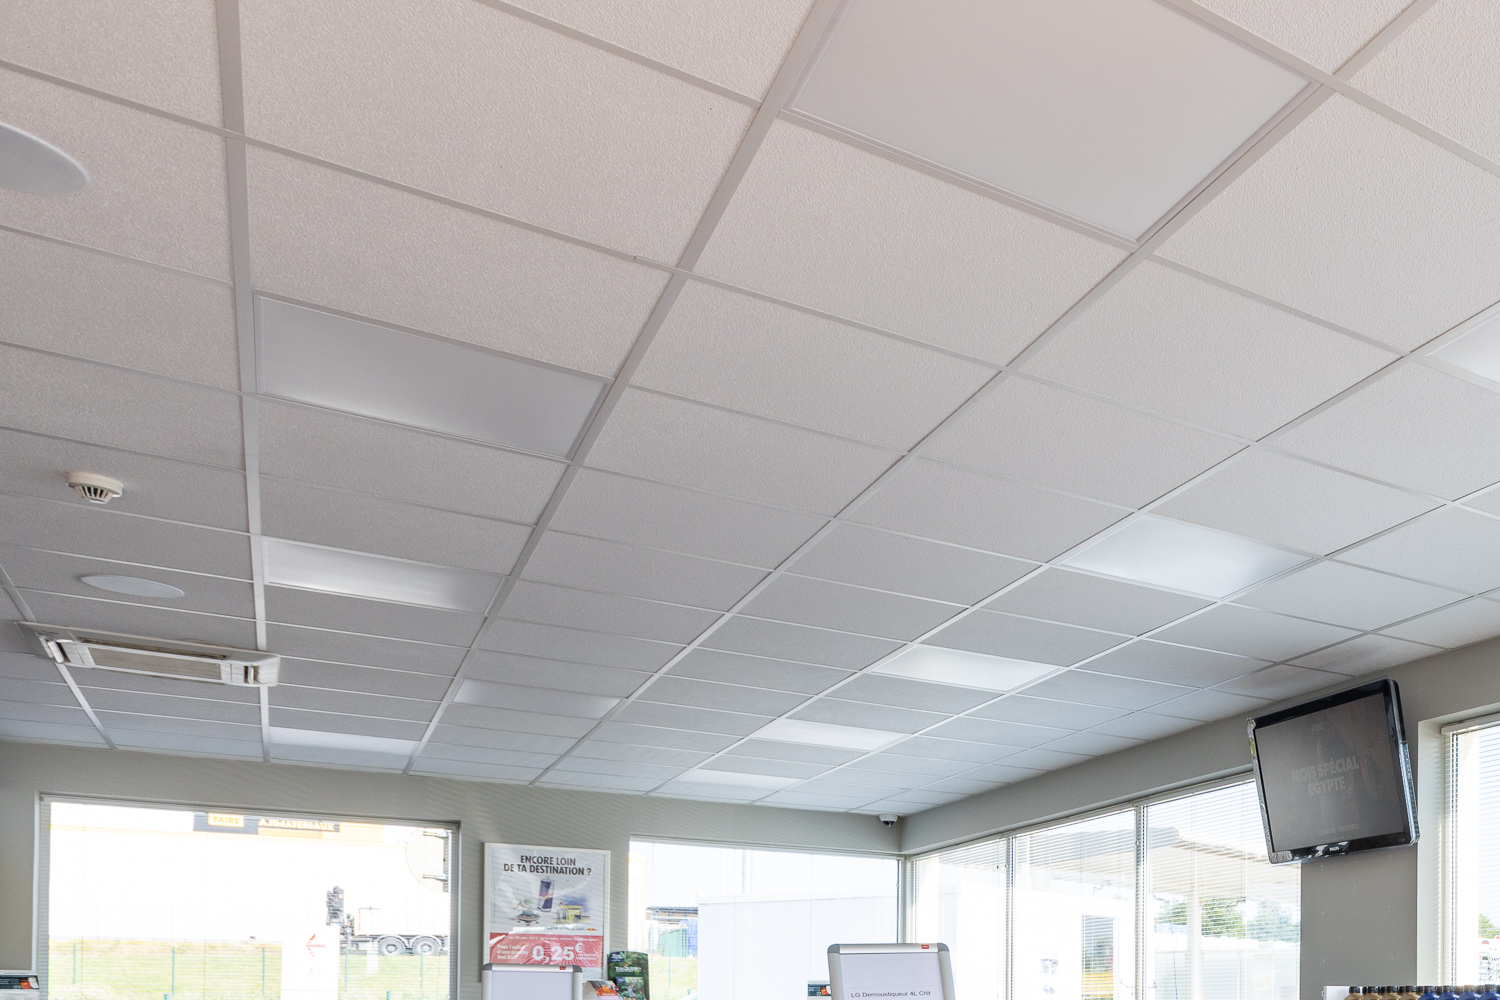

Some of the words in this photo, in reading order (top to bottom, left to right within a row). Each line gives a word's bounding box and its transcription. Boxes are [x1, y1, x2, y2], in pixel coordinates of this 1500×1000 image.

[1307, 776, 1347, 797] ÉGYPTE
[213, 816, 240, 824] FAIRE
[520, 855, 553, 865] ENCORE
[556, 857, 576, 866] LOIN
[503, 863, 514, 872] DE
[517, 864, 527, 873] TA
[529, 865, 585, 876] DESTINATION
[587, 867, 592, 876] ?
